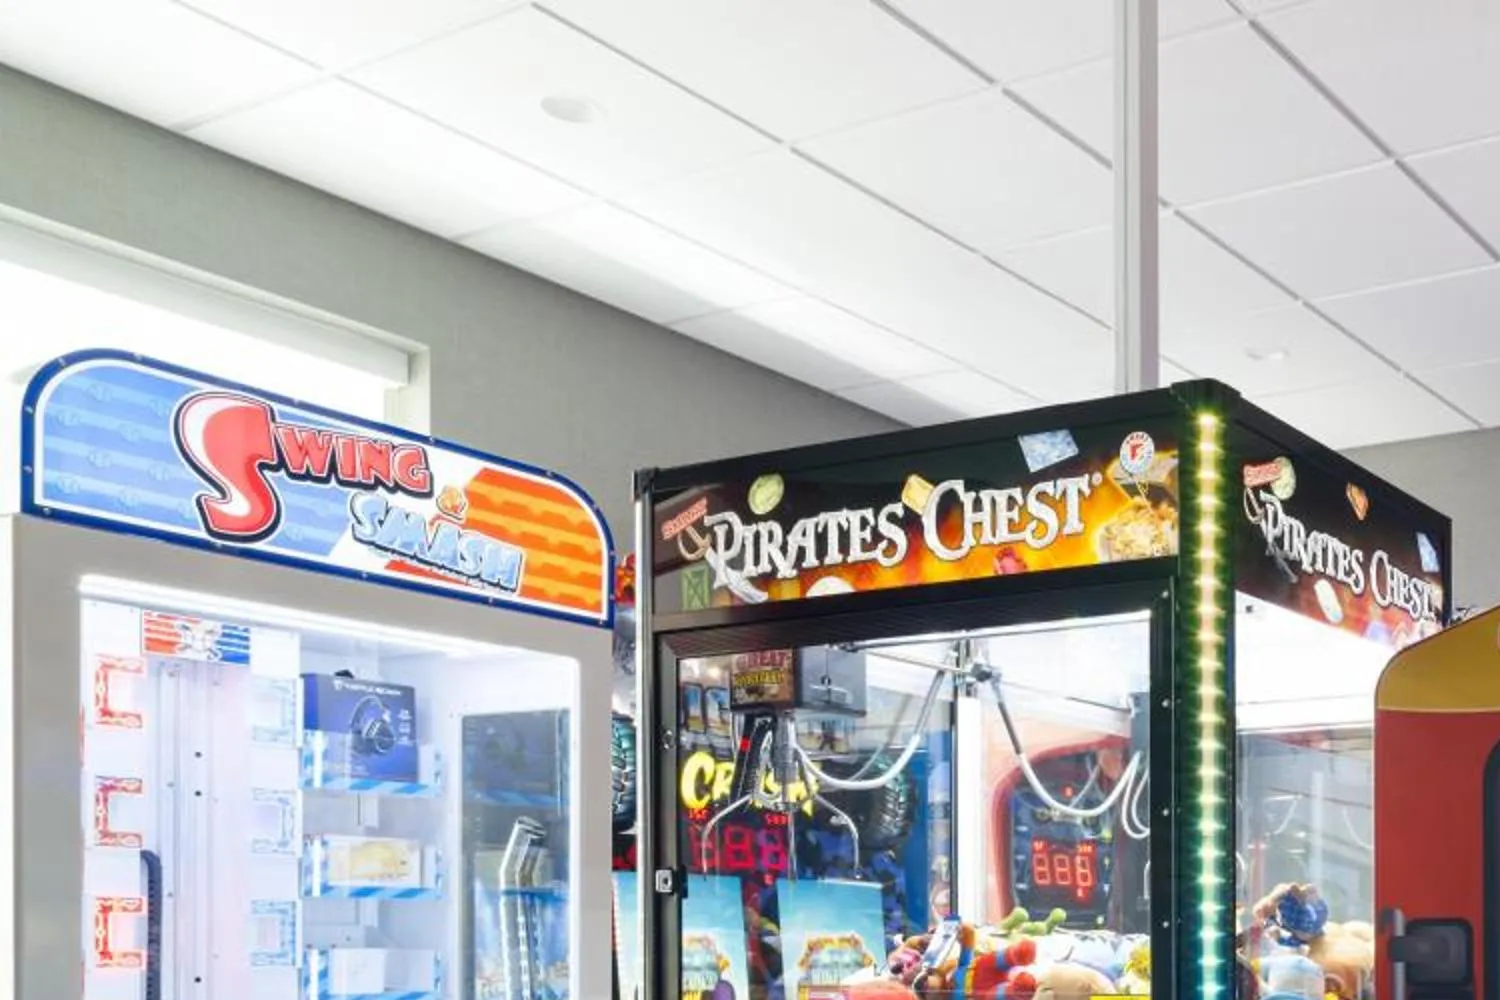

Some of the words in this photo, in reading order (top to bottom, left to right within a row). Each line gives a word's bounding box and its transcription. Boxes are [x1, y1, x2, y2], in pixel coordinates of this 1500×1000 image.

[173, 391, 433, 543] SWING
[351, 494, 523, 592] SMASH
[704, 503, 906, 588] PIRATES
[921, 475, 1090, 560] CHEST
[1259, 489, 1365, 595] PIRATES
[1369, 550, 1438, 620] CHEST
